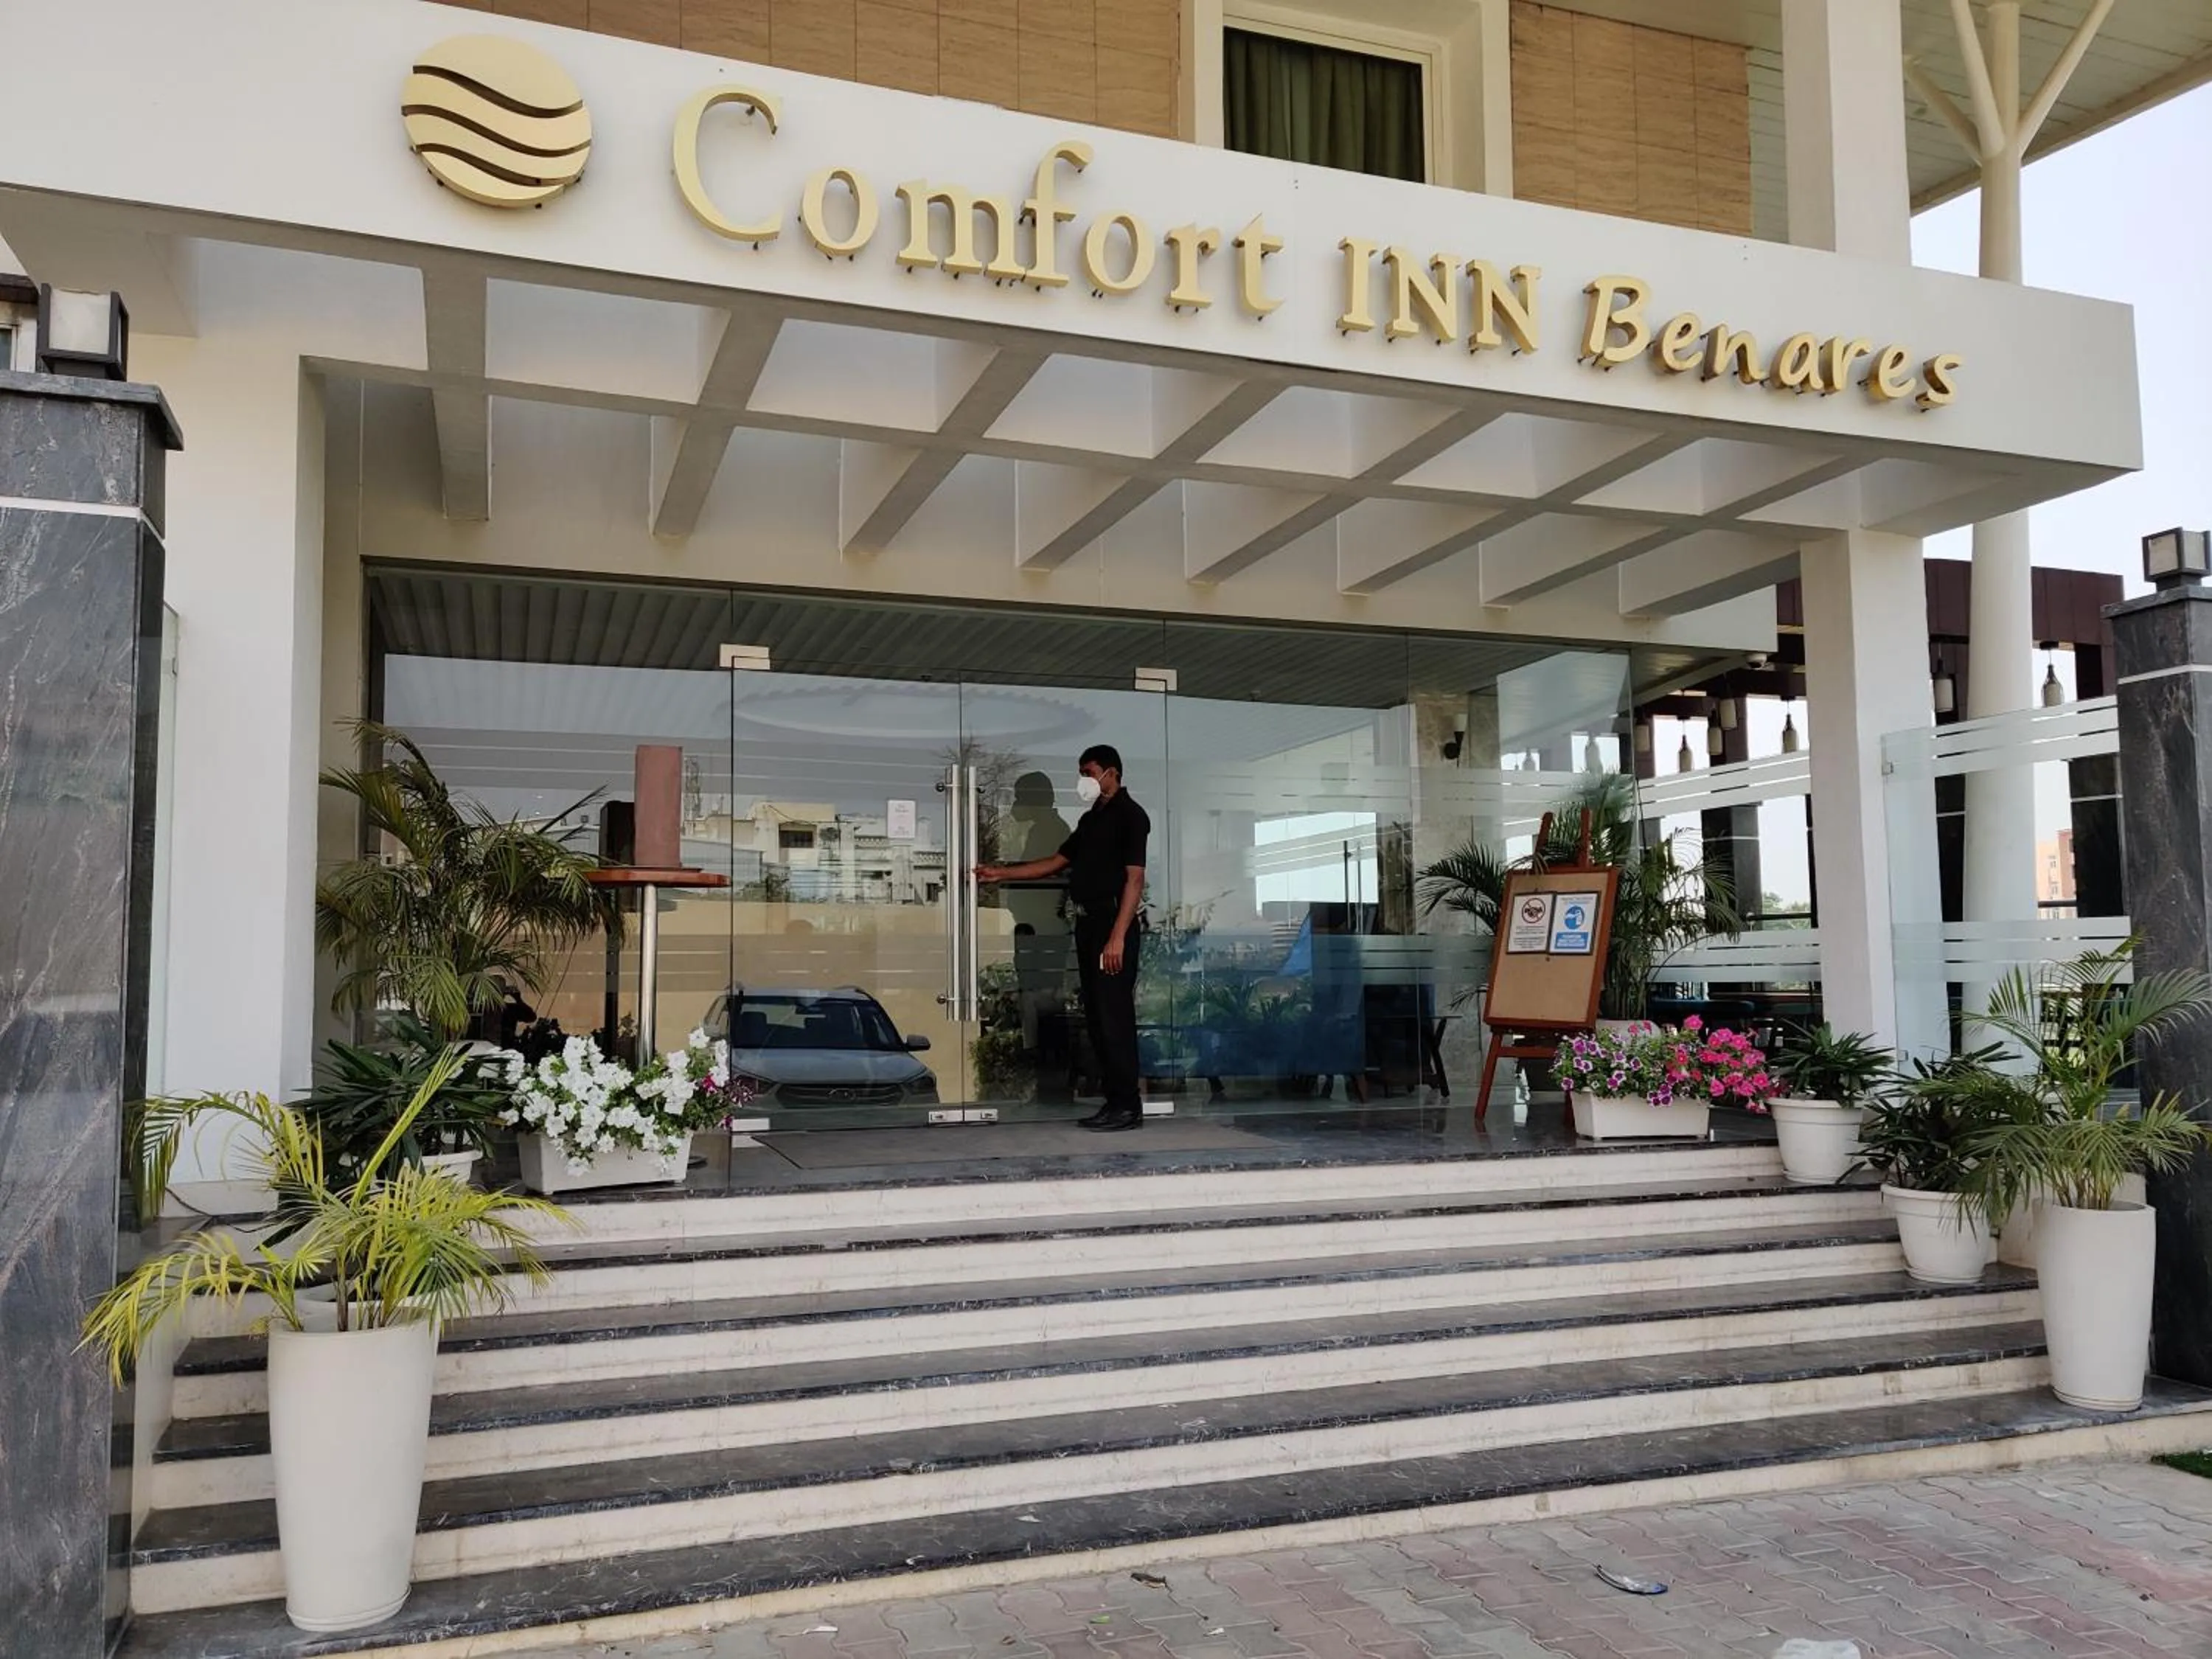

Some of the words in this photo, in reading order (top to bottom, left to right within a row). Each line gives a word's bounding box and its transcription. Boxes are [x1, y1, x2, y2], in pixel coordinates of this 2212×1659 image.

[672, 83, 1283, 316] Comfort
[1335, 236, 1542, 354] INN
[1582, 275, 1963, 409] Benares
